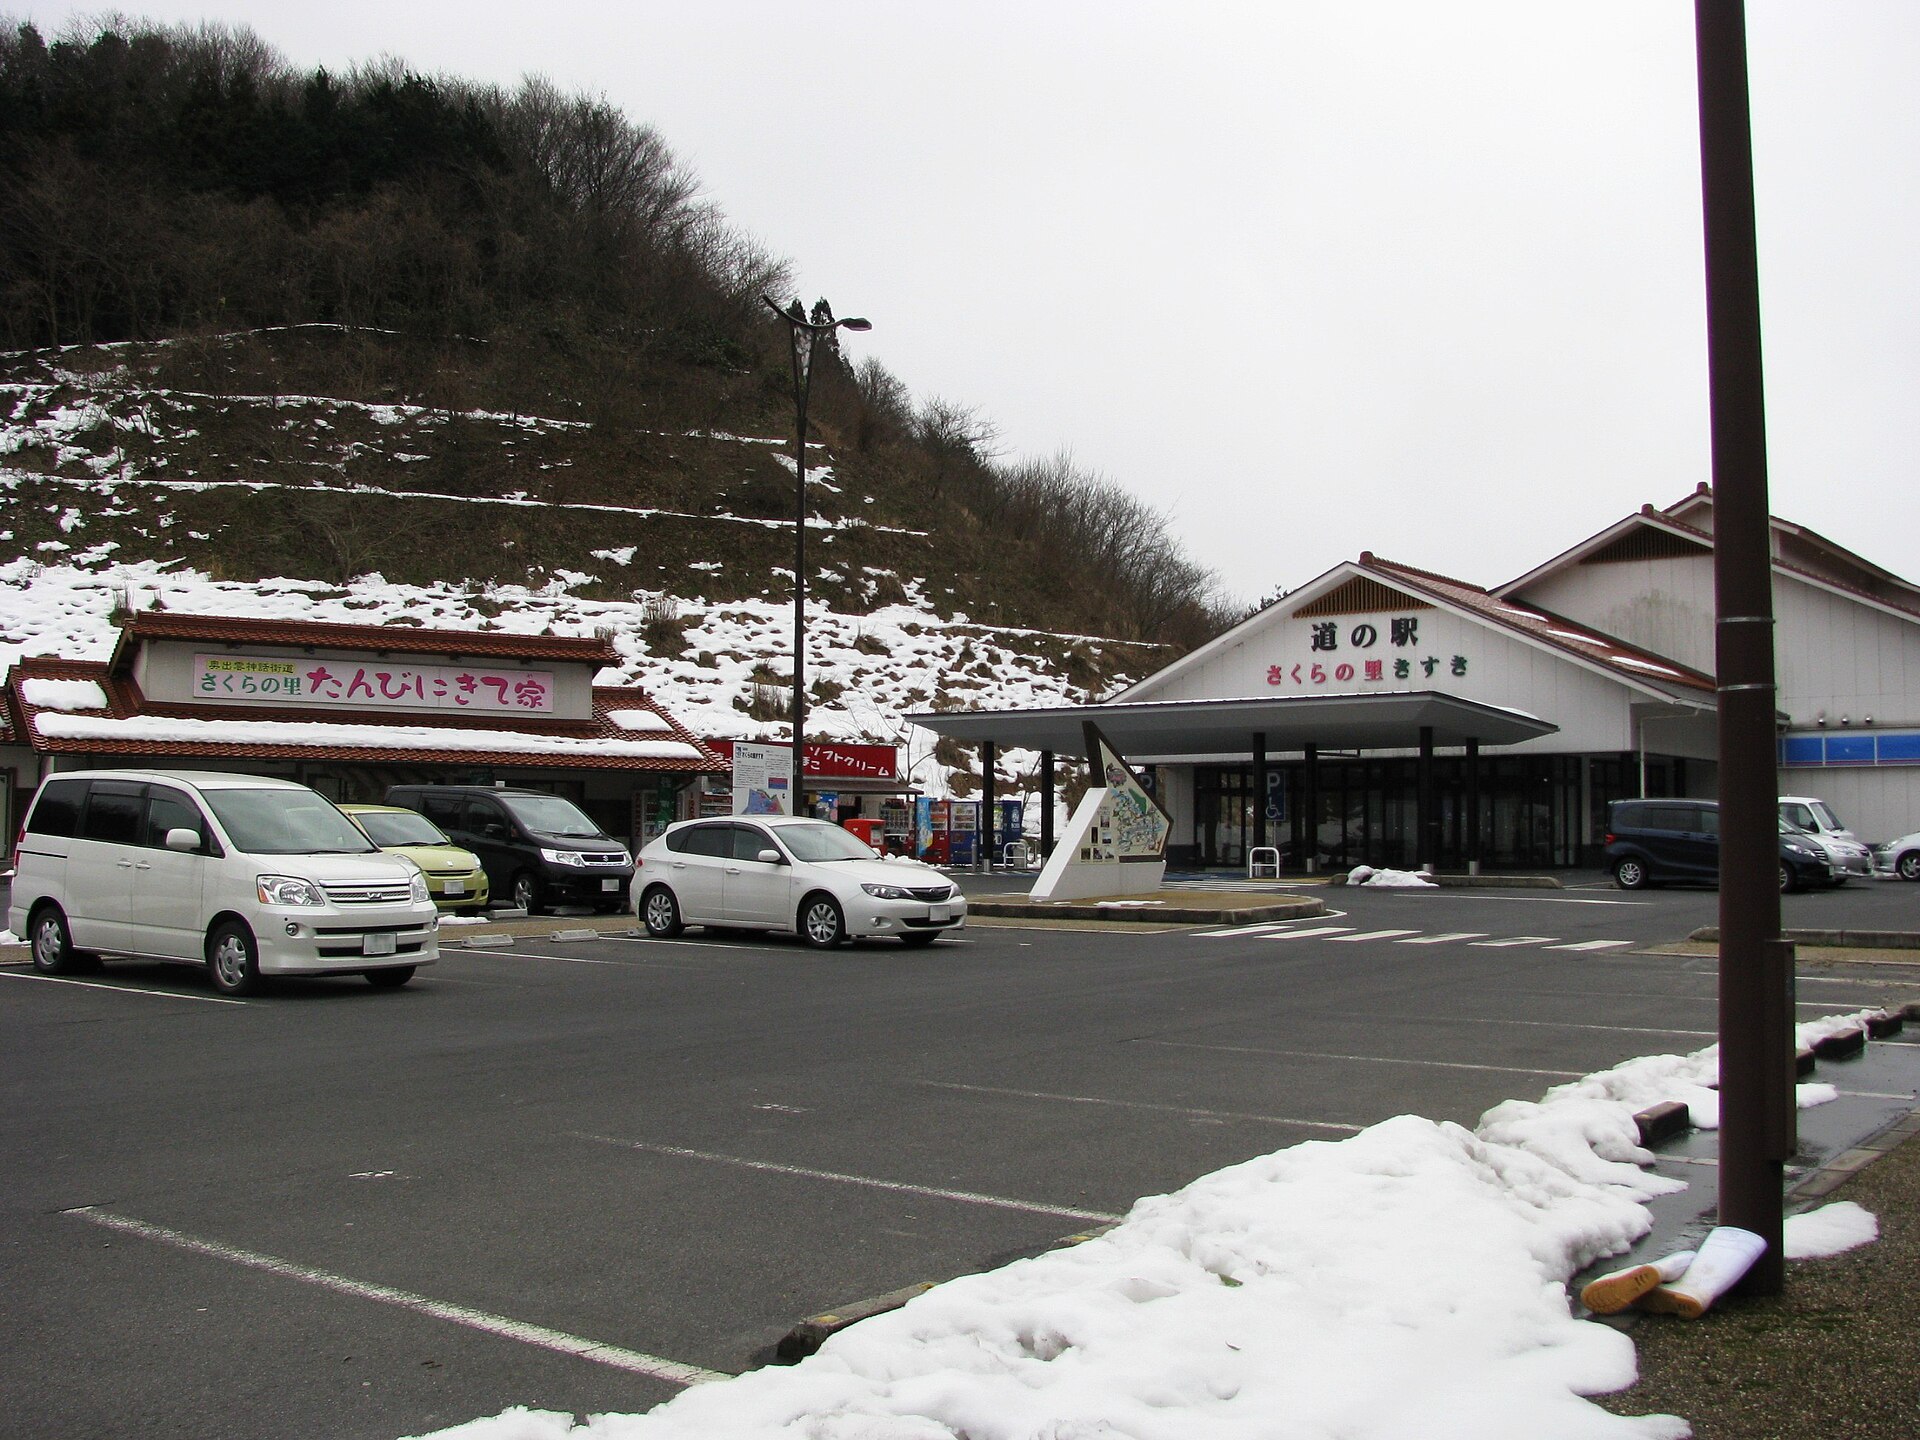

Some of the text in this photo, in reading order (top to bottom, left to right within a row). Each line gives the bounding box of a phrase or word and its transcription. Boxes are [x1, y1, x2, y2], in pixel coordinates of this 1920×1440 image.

[1311, 617, 1418, 651] 道の駅
[201, 673, 302, 695] さくらの里
[1267, 655, 1468, 685] さくらの里きすき
[306, 666, 546, 709] たんびにきて家
[809, 746, 889, 776] ソフトクリーム
[1266, 773, 1281, 794] P
